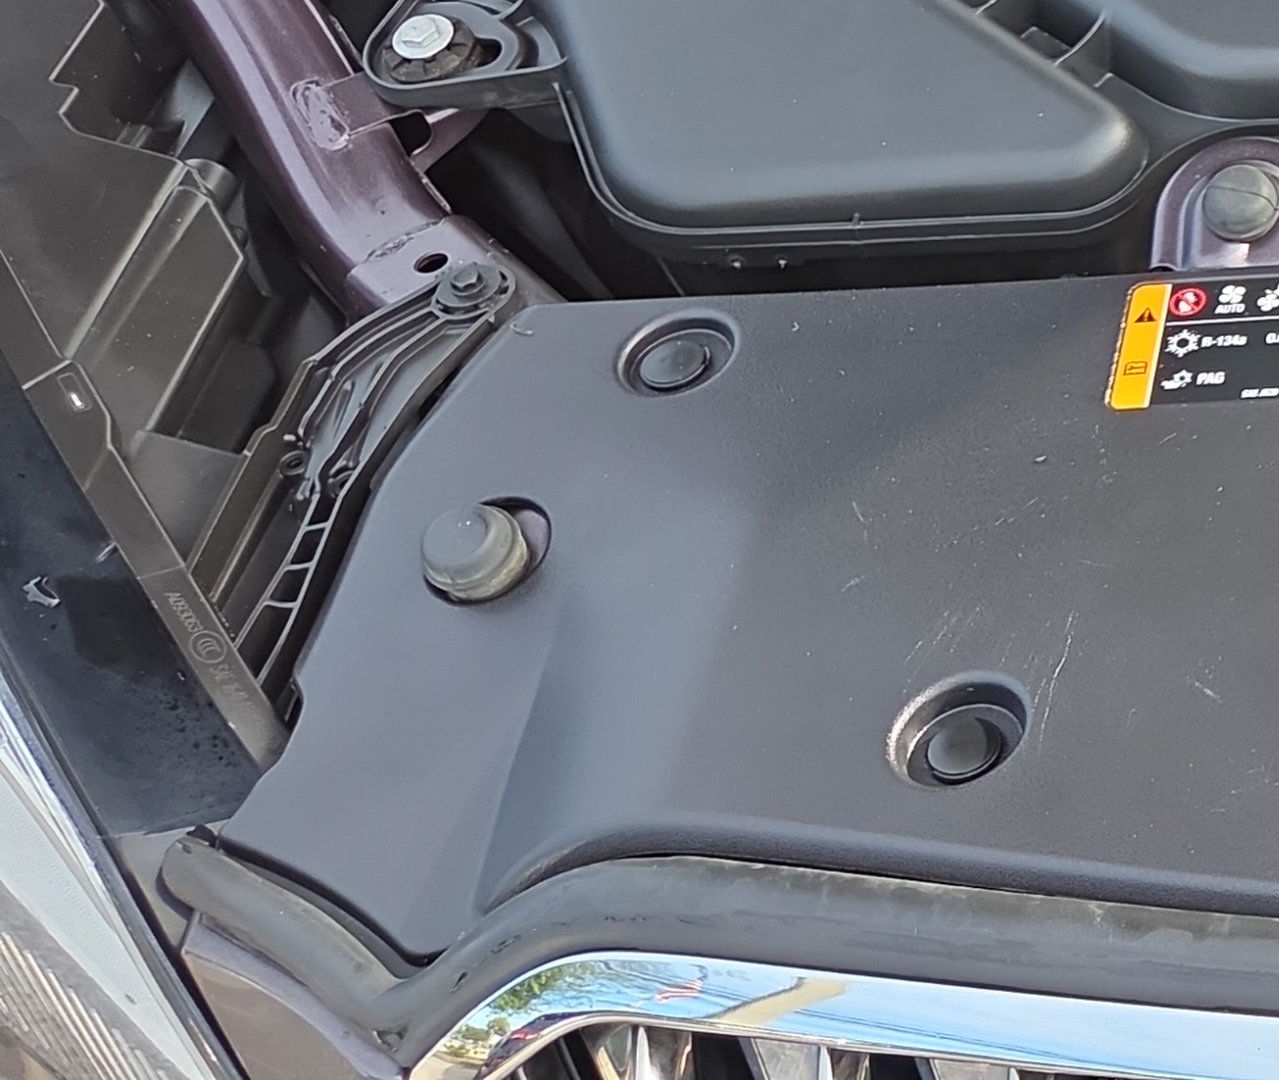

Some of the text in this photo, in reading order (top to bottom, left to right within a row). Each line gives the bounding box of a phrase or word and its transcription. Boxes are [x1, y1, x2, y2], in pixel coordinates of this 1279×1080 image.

[1214, 303, 1246, 315] AUTO
[1201, 333, 1248, 348] R-134a
[1196, 371, 1226, 385] PAG
